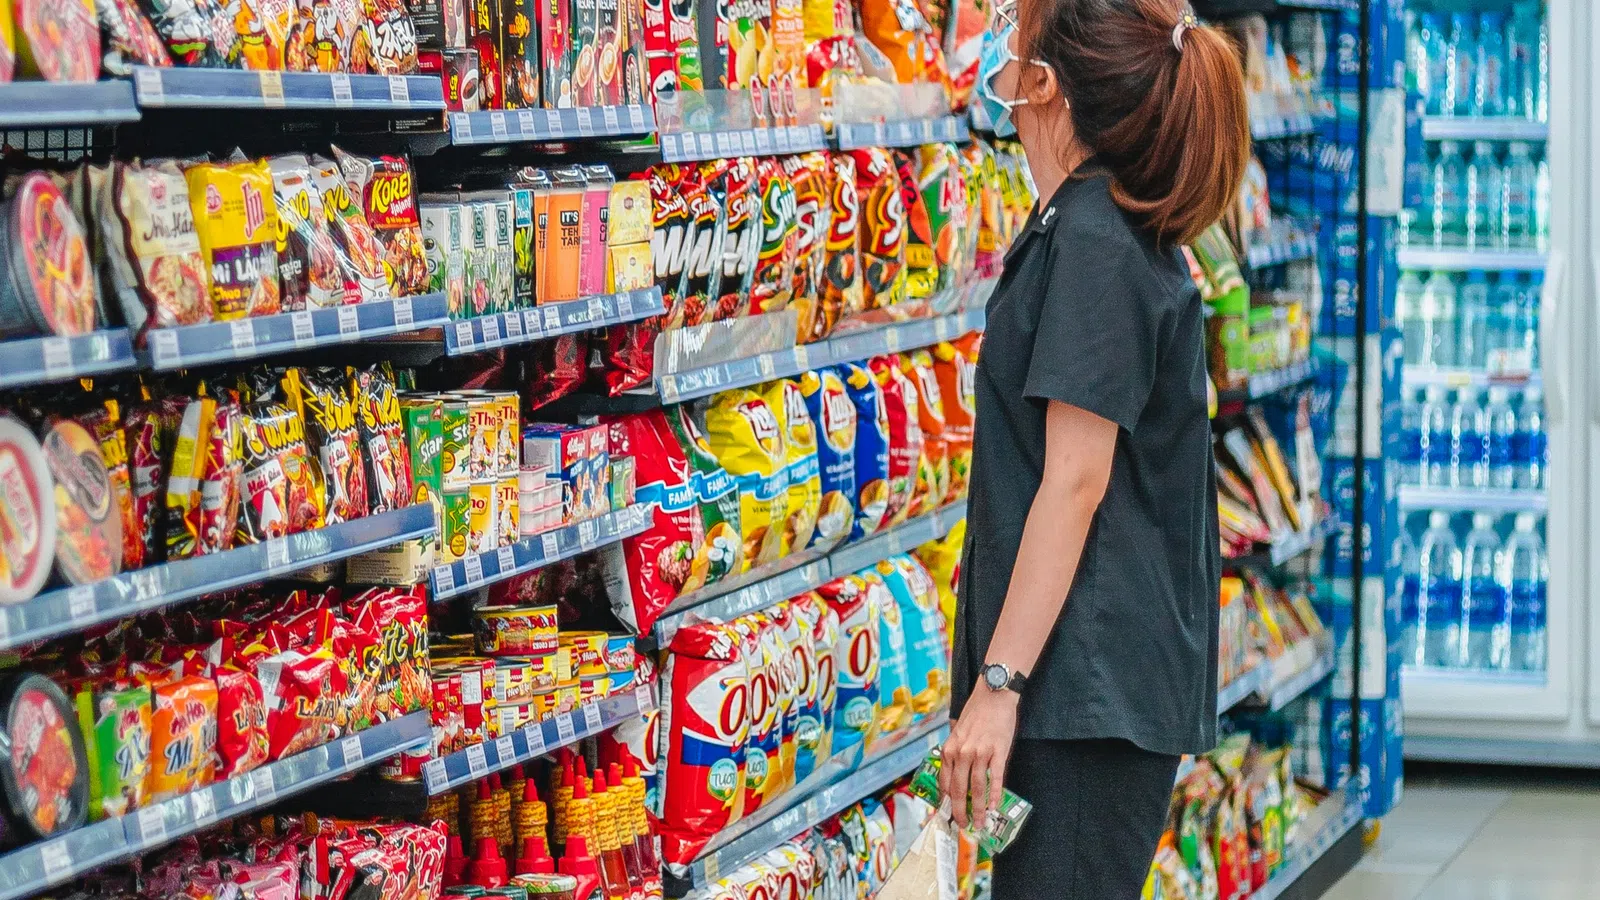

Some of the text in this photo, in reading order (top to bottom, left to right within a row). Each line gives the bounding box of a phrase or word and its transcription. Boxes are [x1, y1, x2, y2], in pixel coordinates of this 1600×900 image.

[371, 170, 411, 214] KORE
[561, 211, 579, 223] IT'S
[561, 227, 579, 237] TEH
